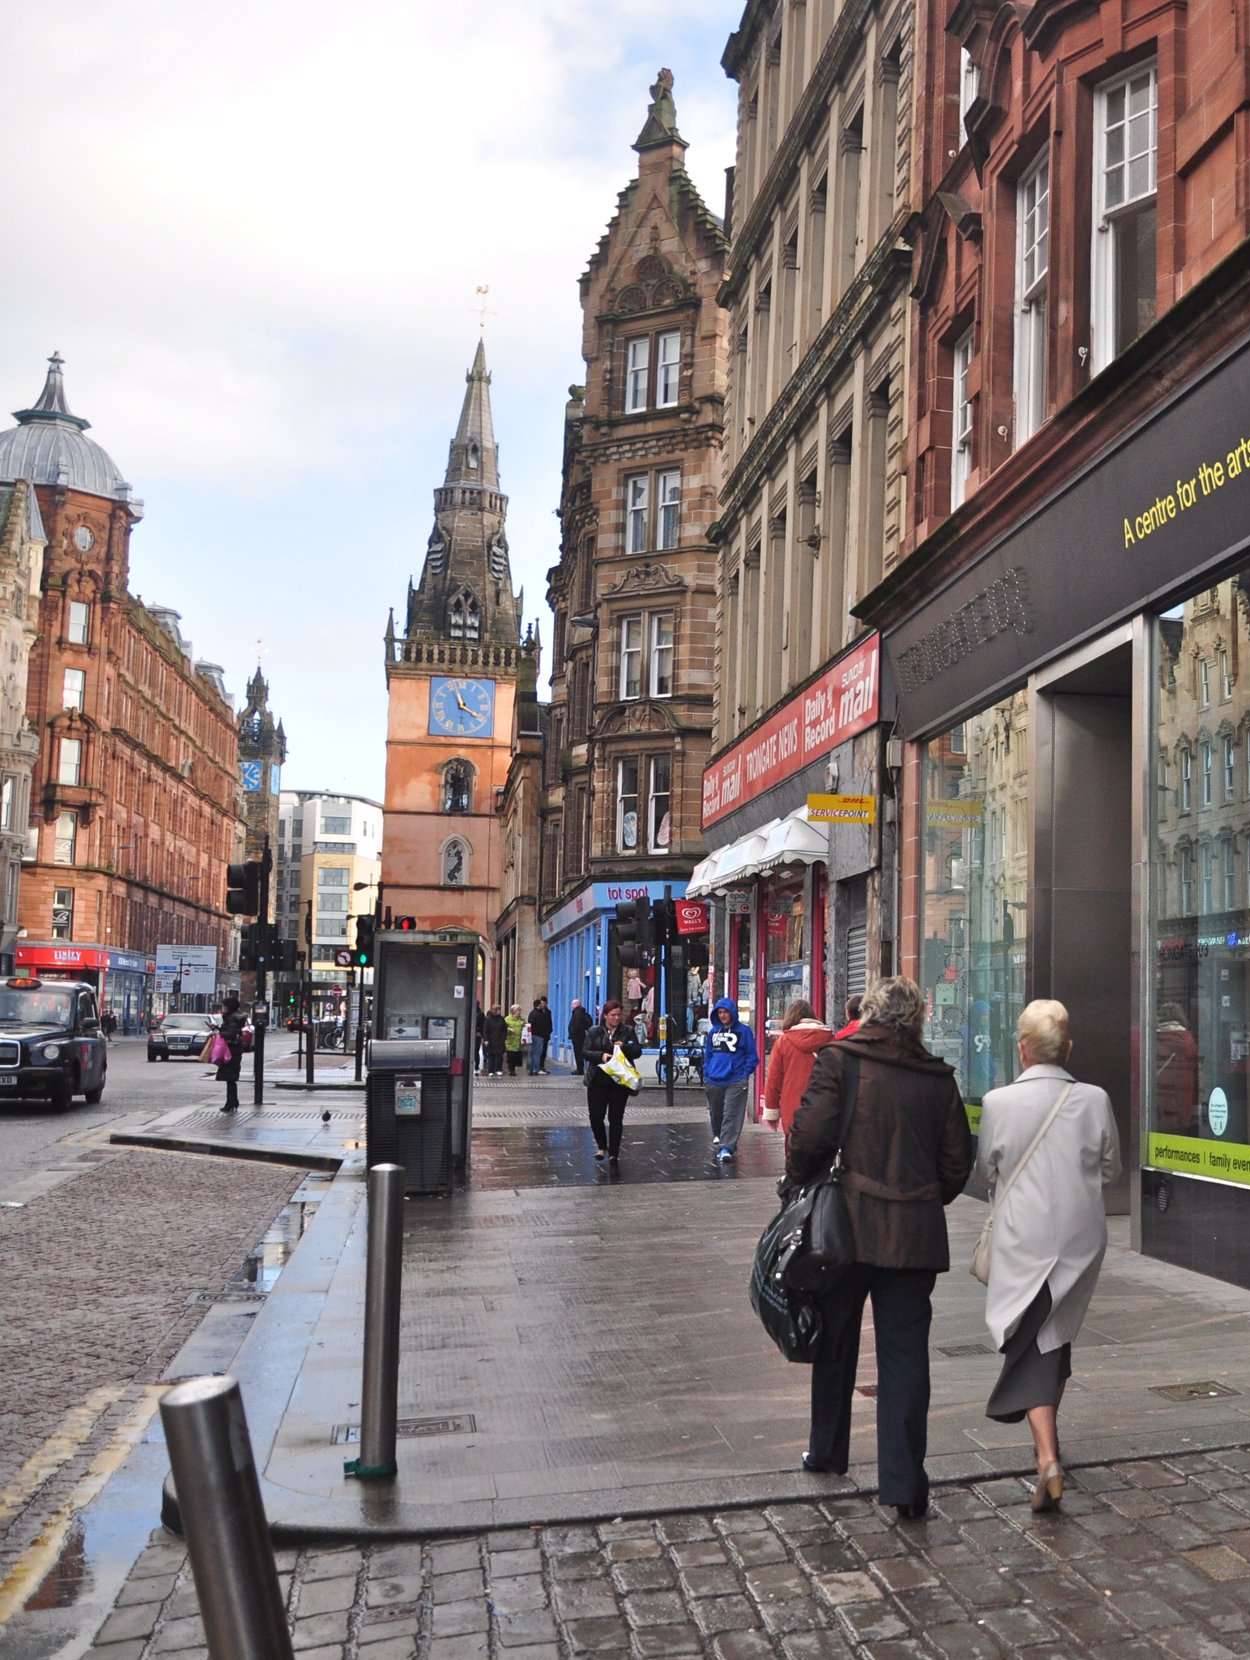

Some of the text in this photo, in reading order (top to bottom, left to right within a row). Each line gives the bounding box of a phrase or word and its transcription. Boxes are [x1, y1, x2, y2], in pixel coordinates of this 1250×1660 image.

[1123, 518, 1135, 548] A
[1135, 497, 1176, 538] centre
[1177, 480, 1197, 511] for
[1198, 463, 1224, 496] the
[838, 649, 877, 729] mail
[841, 659, 866, 689] SUNDAY
[805, 690, 826, 725] Daily
[804, 708, 836, 753] Record
[746, 717, 798, 784] TRONGATE NEWS
[811, 808, 869, 818] SERVICEPOINT
[607, 885, 648, 900] tot spot
[1154, 1145, 1200, 1164] performances
[1209, 1152, 1231, 1172] family
